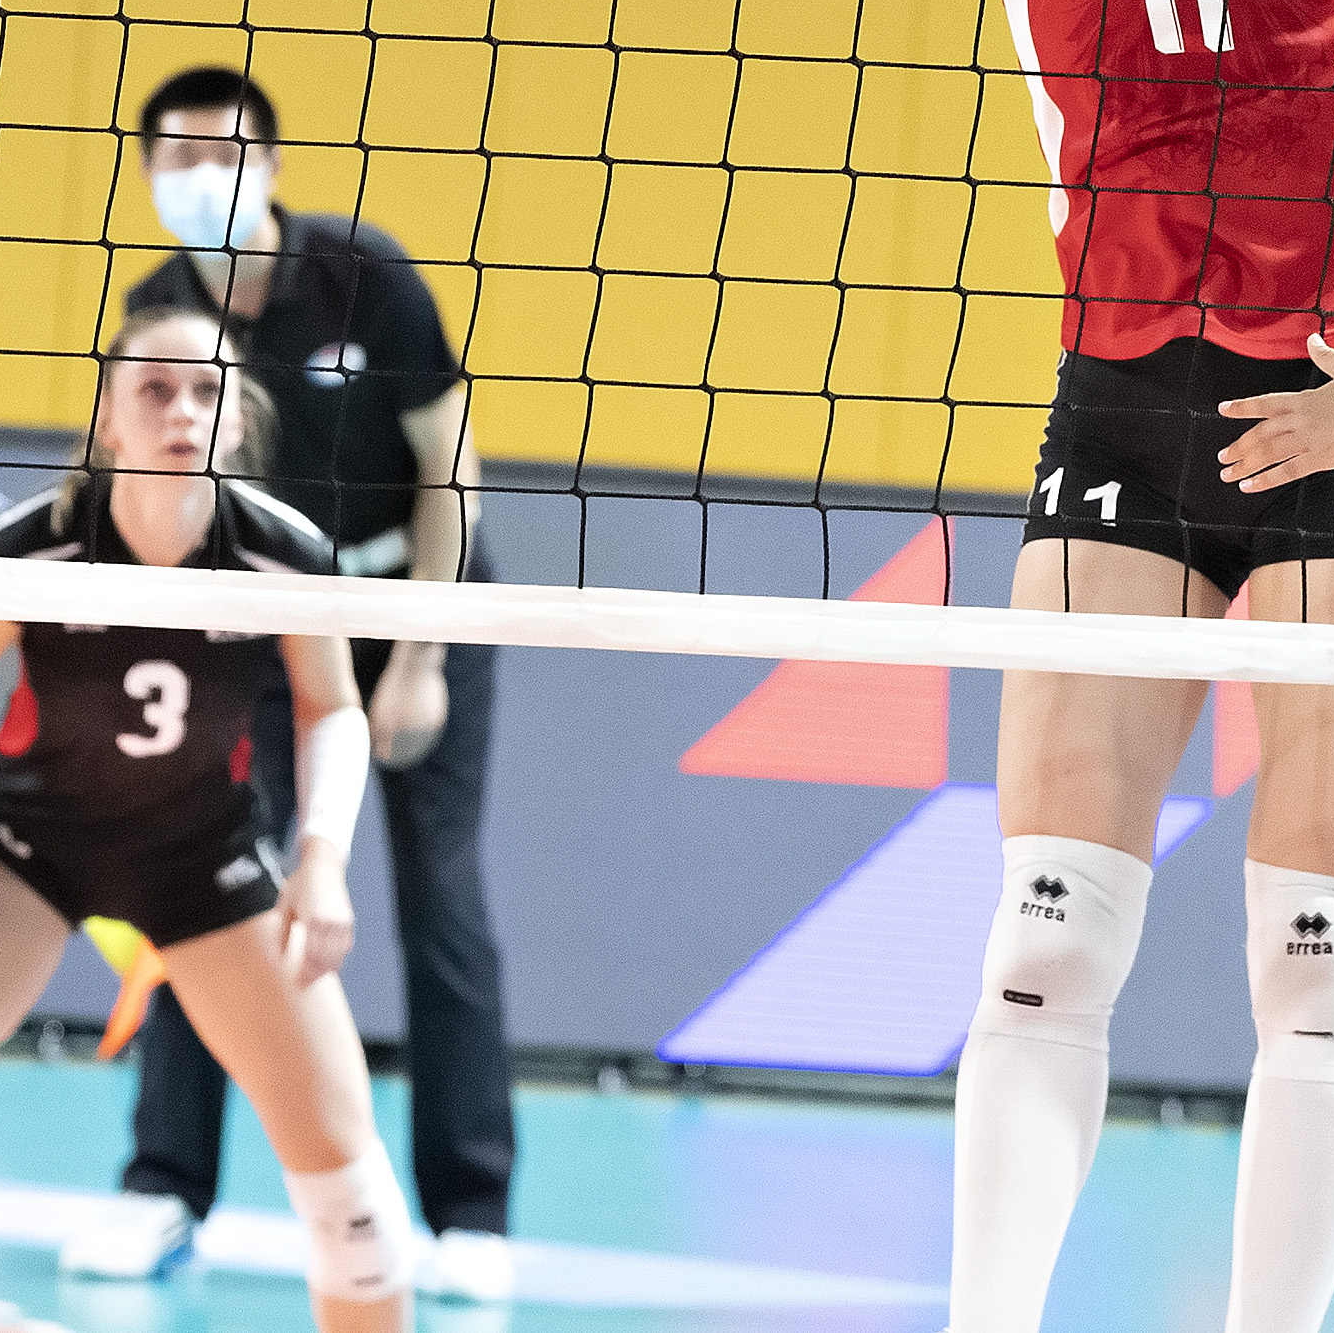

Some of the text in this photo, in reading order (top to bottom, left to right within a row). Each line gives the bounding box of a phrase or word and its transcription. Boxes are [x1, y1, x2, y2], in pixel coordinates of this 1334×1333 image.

[115, 659, 192, 759] 3
[1020, 901, 1065, 922] errea
[1287, 942, 1333, 955] errea
